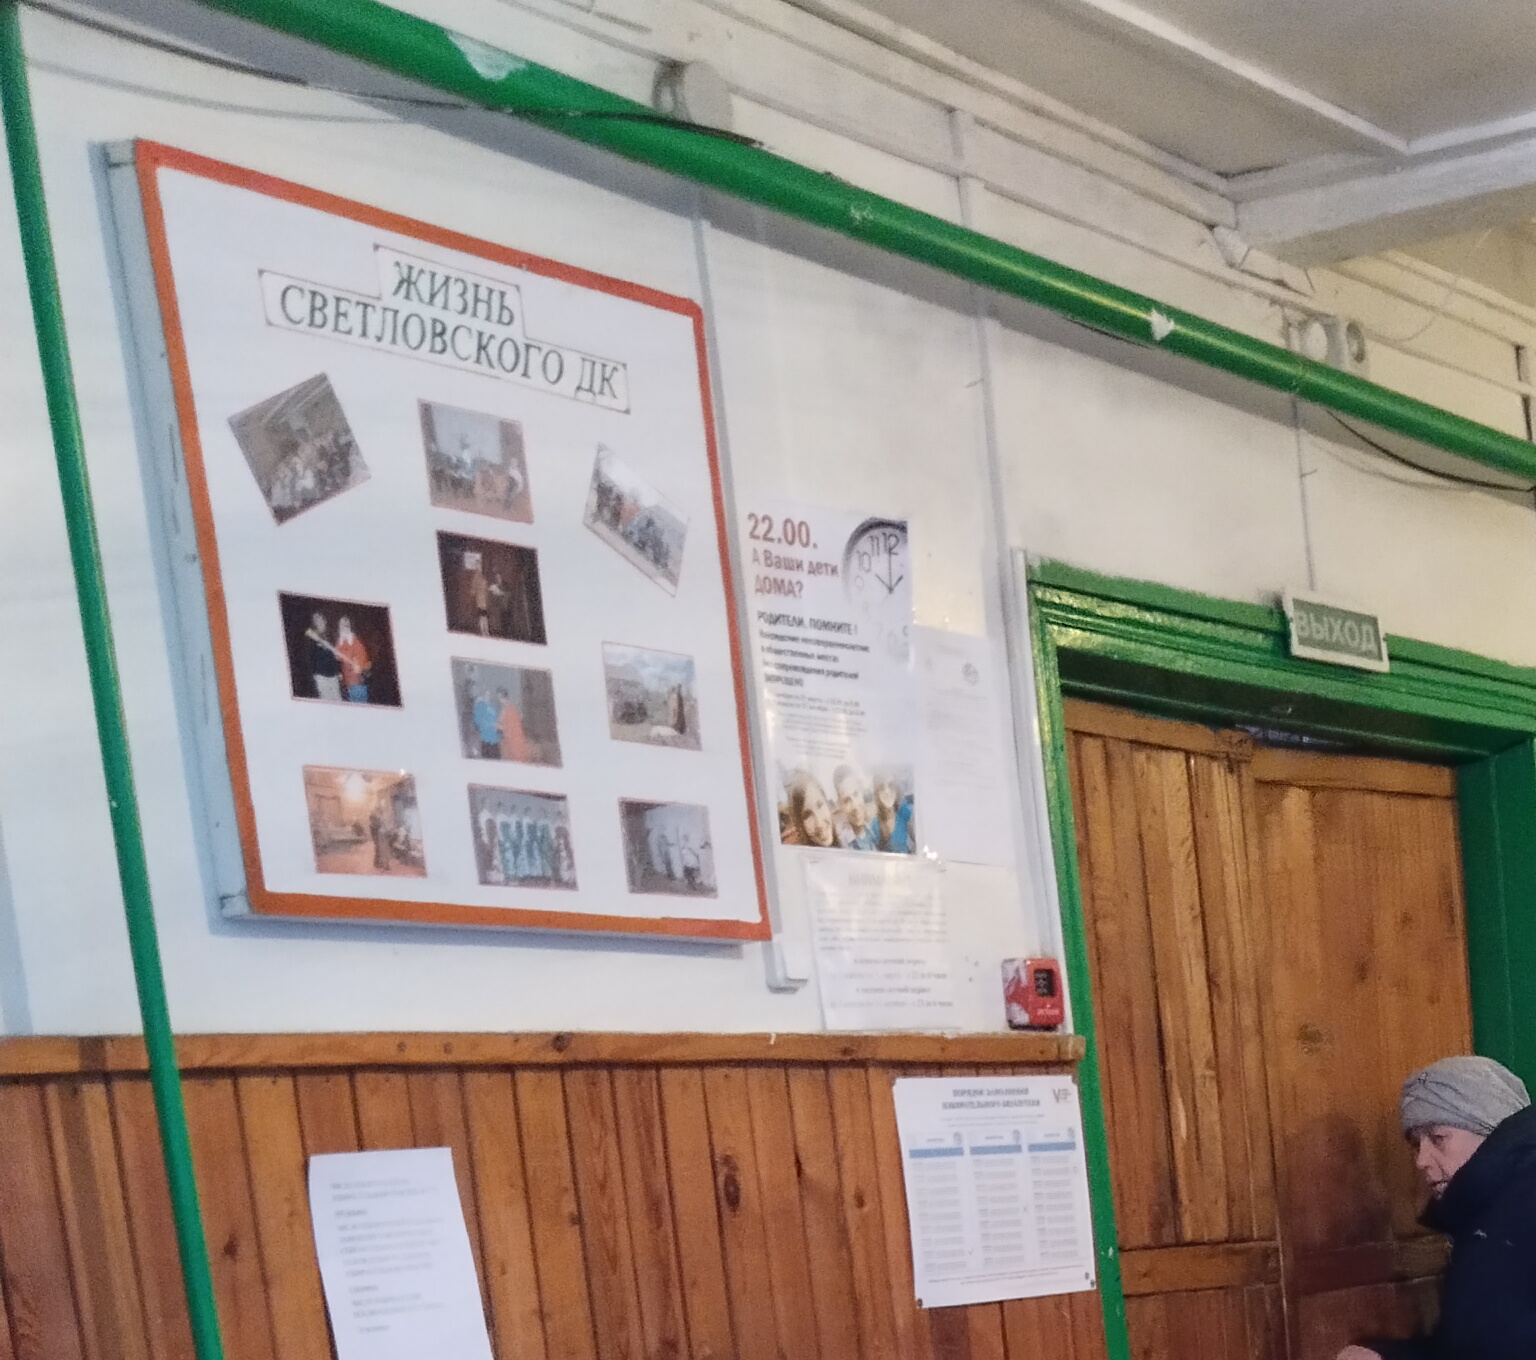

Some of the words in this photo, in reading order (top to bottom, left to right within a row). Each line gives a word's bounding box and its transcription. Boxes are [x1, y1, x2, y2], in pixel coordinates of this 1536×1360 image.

[392, 260, 516, 327] ЖИЗНЬ
[280, 283, 565, 386] СВЕТЛОВСКОГО
[574, 356, 620, 401] ДК
[747, 512, 818, 549] 22.00.
[763, 549, 804, 573] Ваши
[807, 560, 839, 578] дети
[755, 574, 804, 599] ДОМА?
[1296, 610, 1376, 651] ВЫХОД
